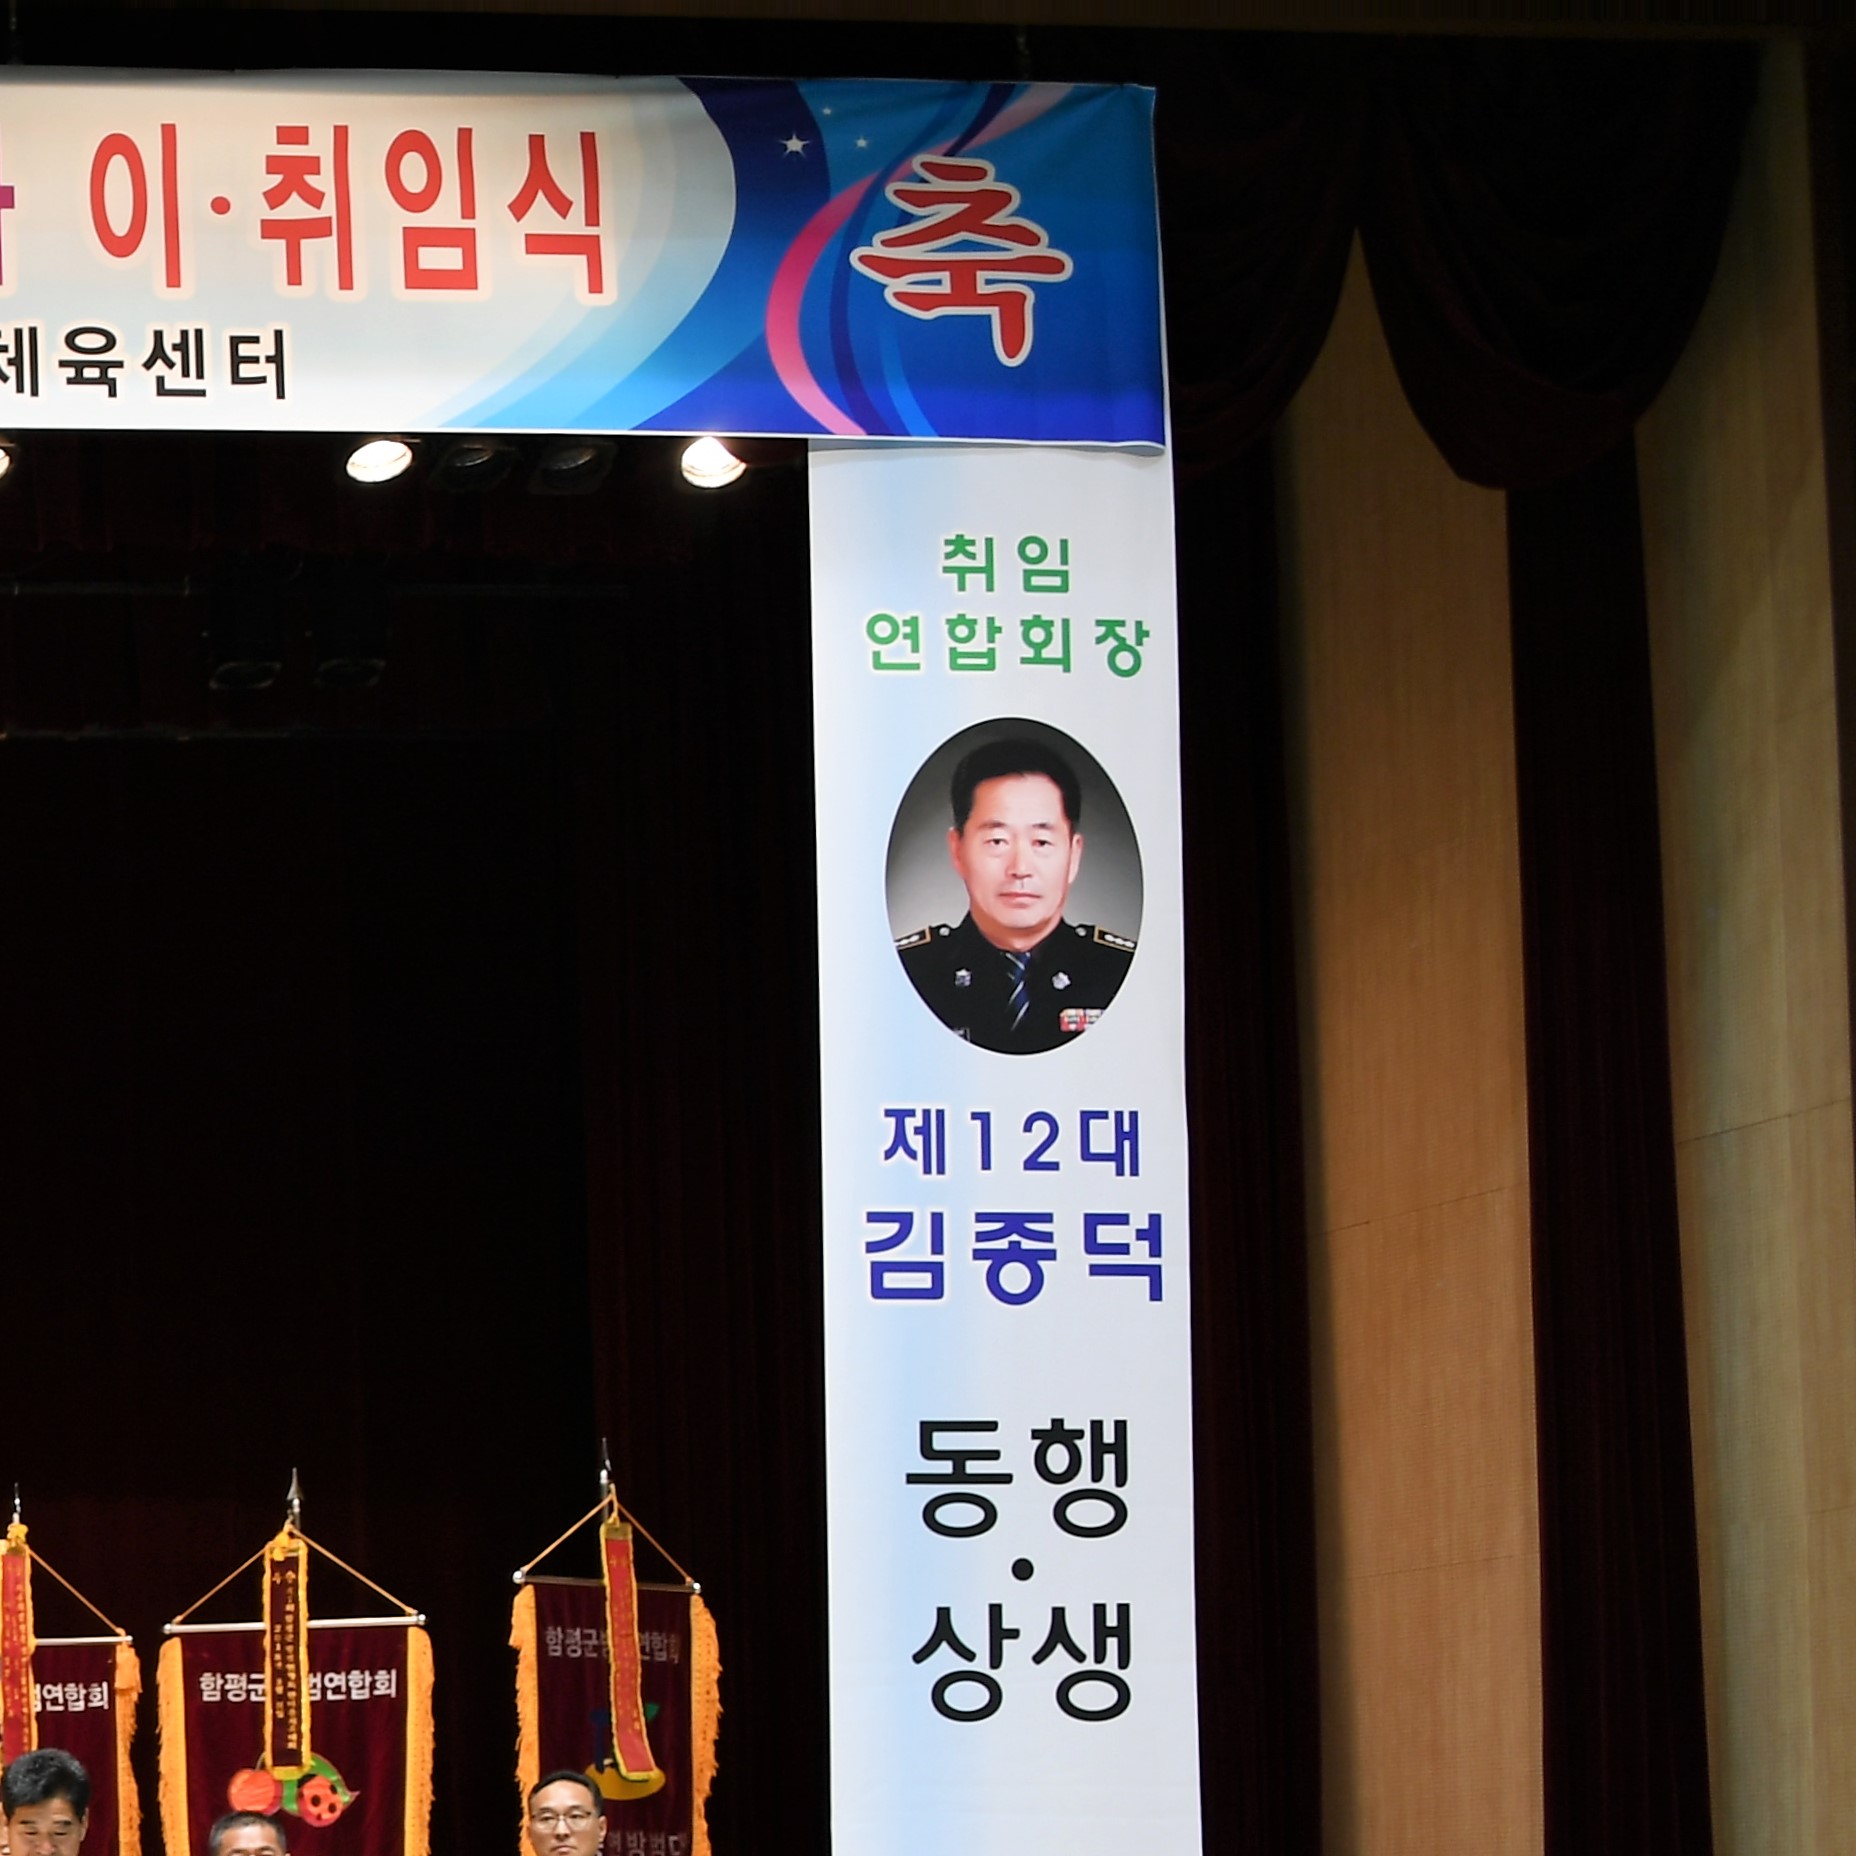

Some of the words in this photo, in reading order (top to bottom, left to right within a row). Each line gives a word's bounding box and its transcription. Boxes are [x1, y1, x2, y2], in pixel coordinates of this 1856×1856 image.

[856, 158, 1068, 360] 축
[943, 534, 1069, 593] 취임
[867, 614, 1150, 678] 연합회장
[884, 1109, 1139, 1177] 제12대
[865, 1211, 1163, 1306] 김종덕
[905, 1418, 1128, 1538] 동행
[912, 1603, 1131, 1722] 상생
